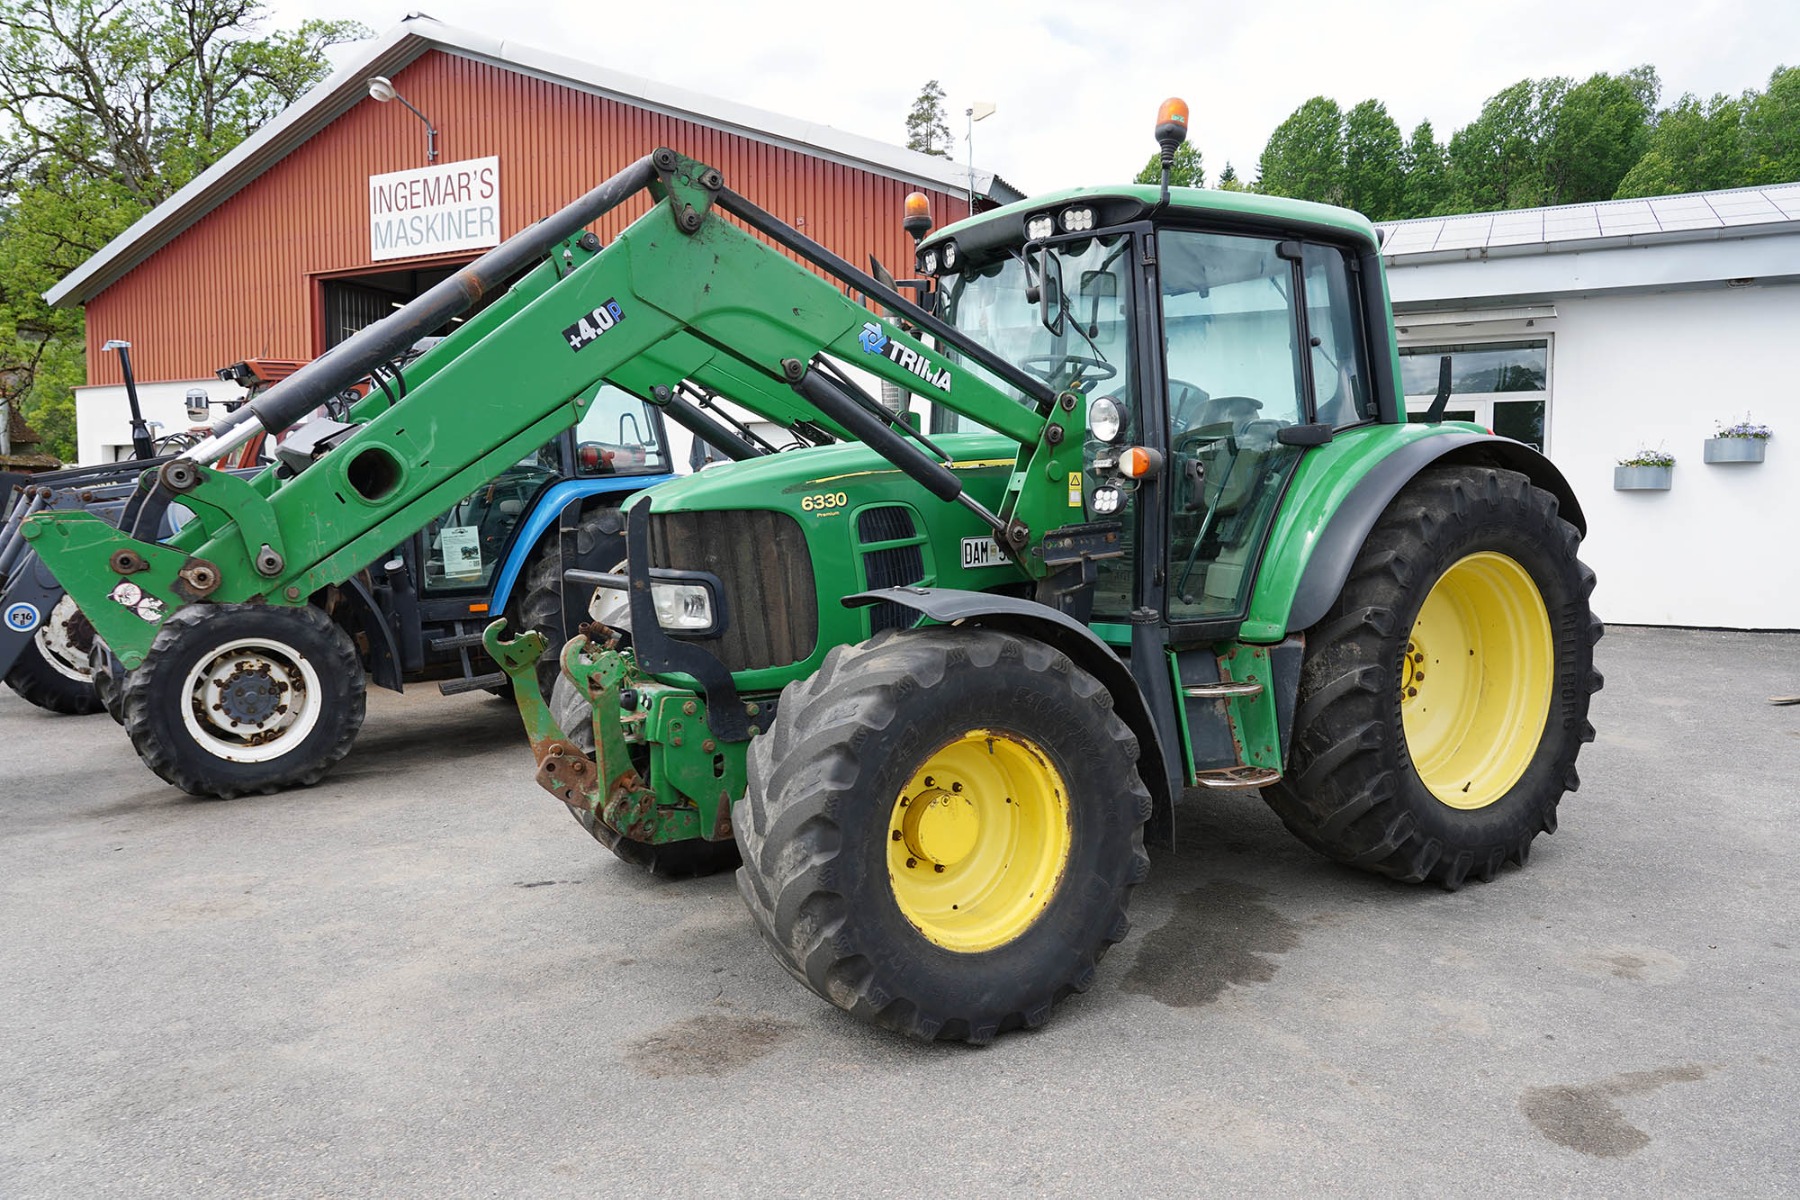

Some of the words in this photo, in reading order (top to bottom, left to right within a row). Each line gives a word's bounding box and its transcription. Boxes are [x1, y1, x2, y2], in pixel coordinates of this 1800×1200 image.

[373, 168, 494, 215] INGEMAR'S
[374, 206, 495, 250] MASKINER
[889, 339, 951, 393] TRIMA
[801, 491, 848, 511] 6330
[964, 541, 988, 565] DAM
